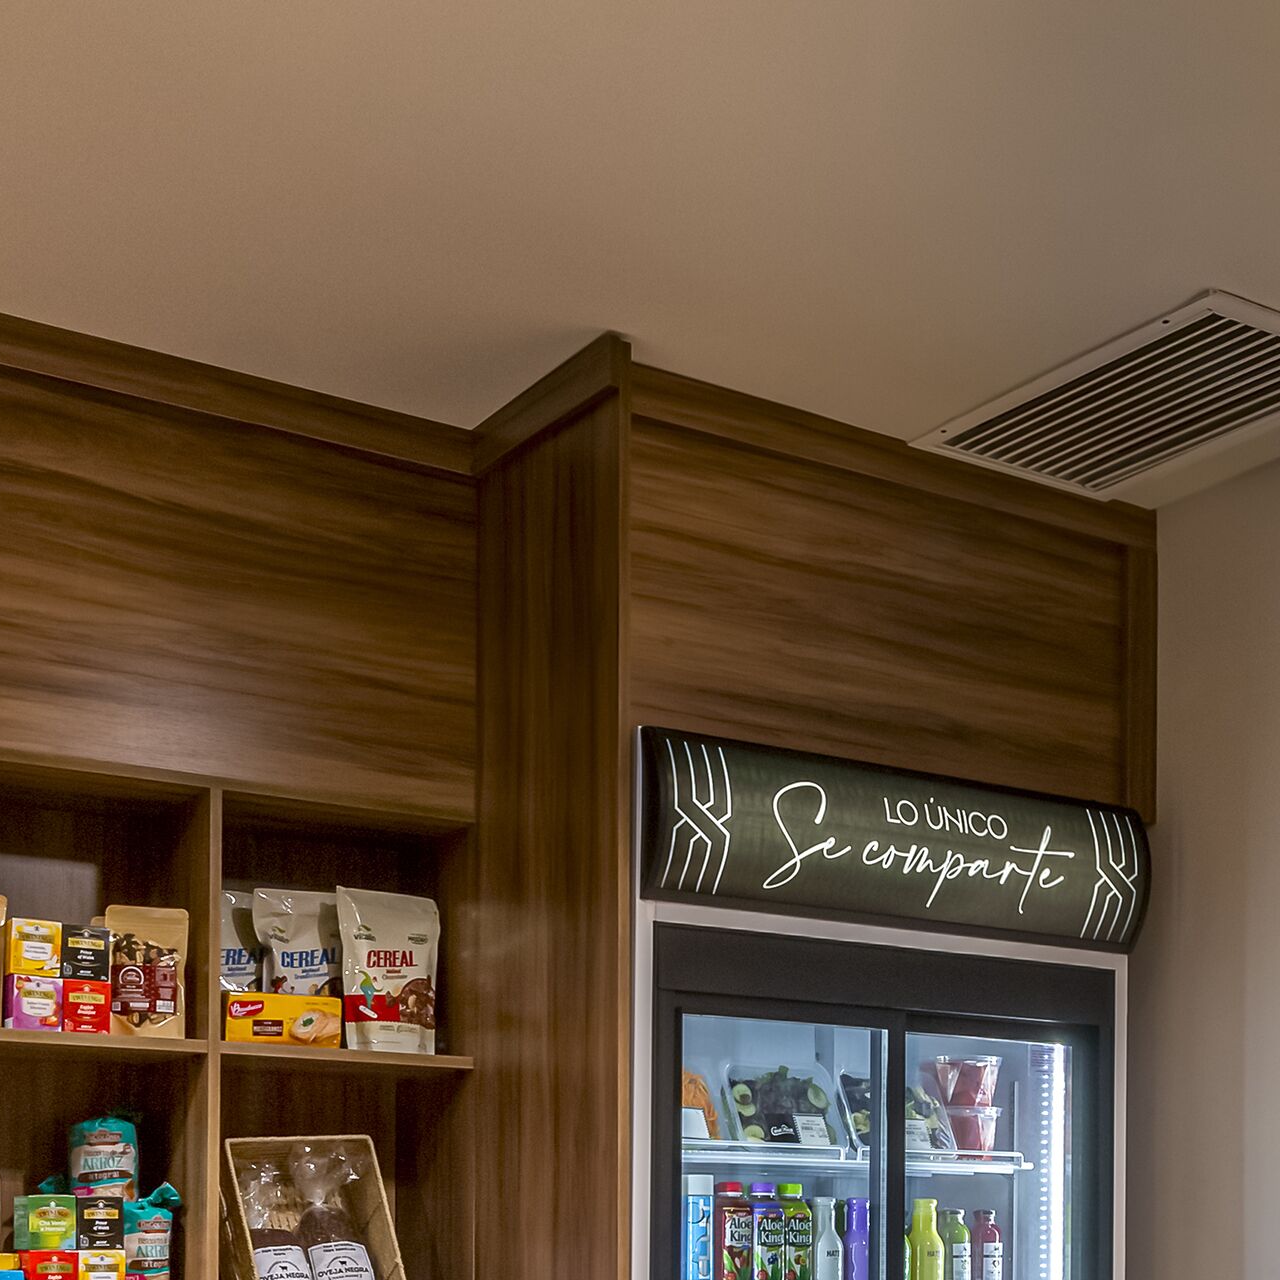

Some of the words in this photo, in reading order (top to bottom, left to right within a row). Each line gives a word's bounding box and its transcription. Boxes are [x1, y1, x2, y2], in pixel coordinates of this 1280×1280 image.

[882, 796, 919, 826] LO
[924, 796, 1008, 841] ÚNICO
[762, 780, 852, 889] Se
[860, 825, 1075, 915] comparte
[280, 948, 337, 968] CEREAL
[366, 949, 418, 968] CEREAL
[83, 1156, 124, 1170] ARROZ
[730, 1218, 752, 1230] Aloe
[760, 1219, 782, 1231] Aloe
[788, 1219, 811, 1231] Aloe
[730, 1232, 752, 1244] King
[760, 1232, 783, 1244] King
[789, 1232, 811, 1245] King
[286, 1271, 309, 1280] NEGRA
[317, 1269, 343, 1278] OVEJA
[345, 1266, 369, 1274] NEGRA
